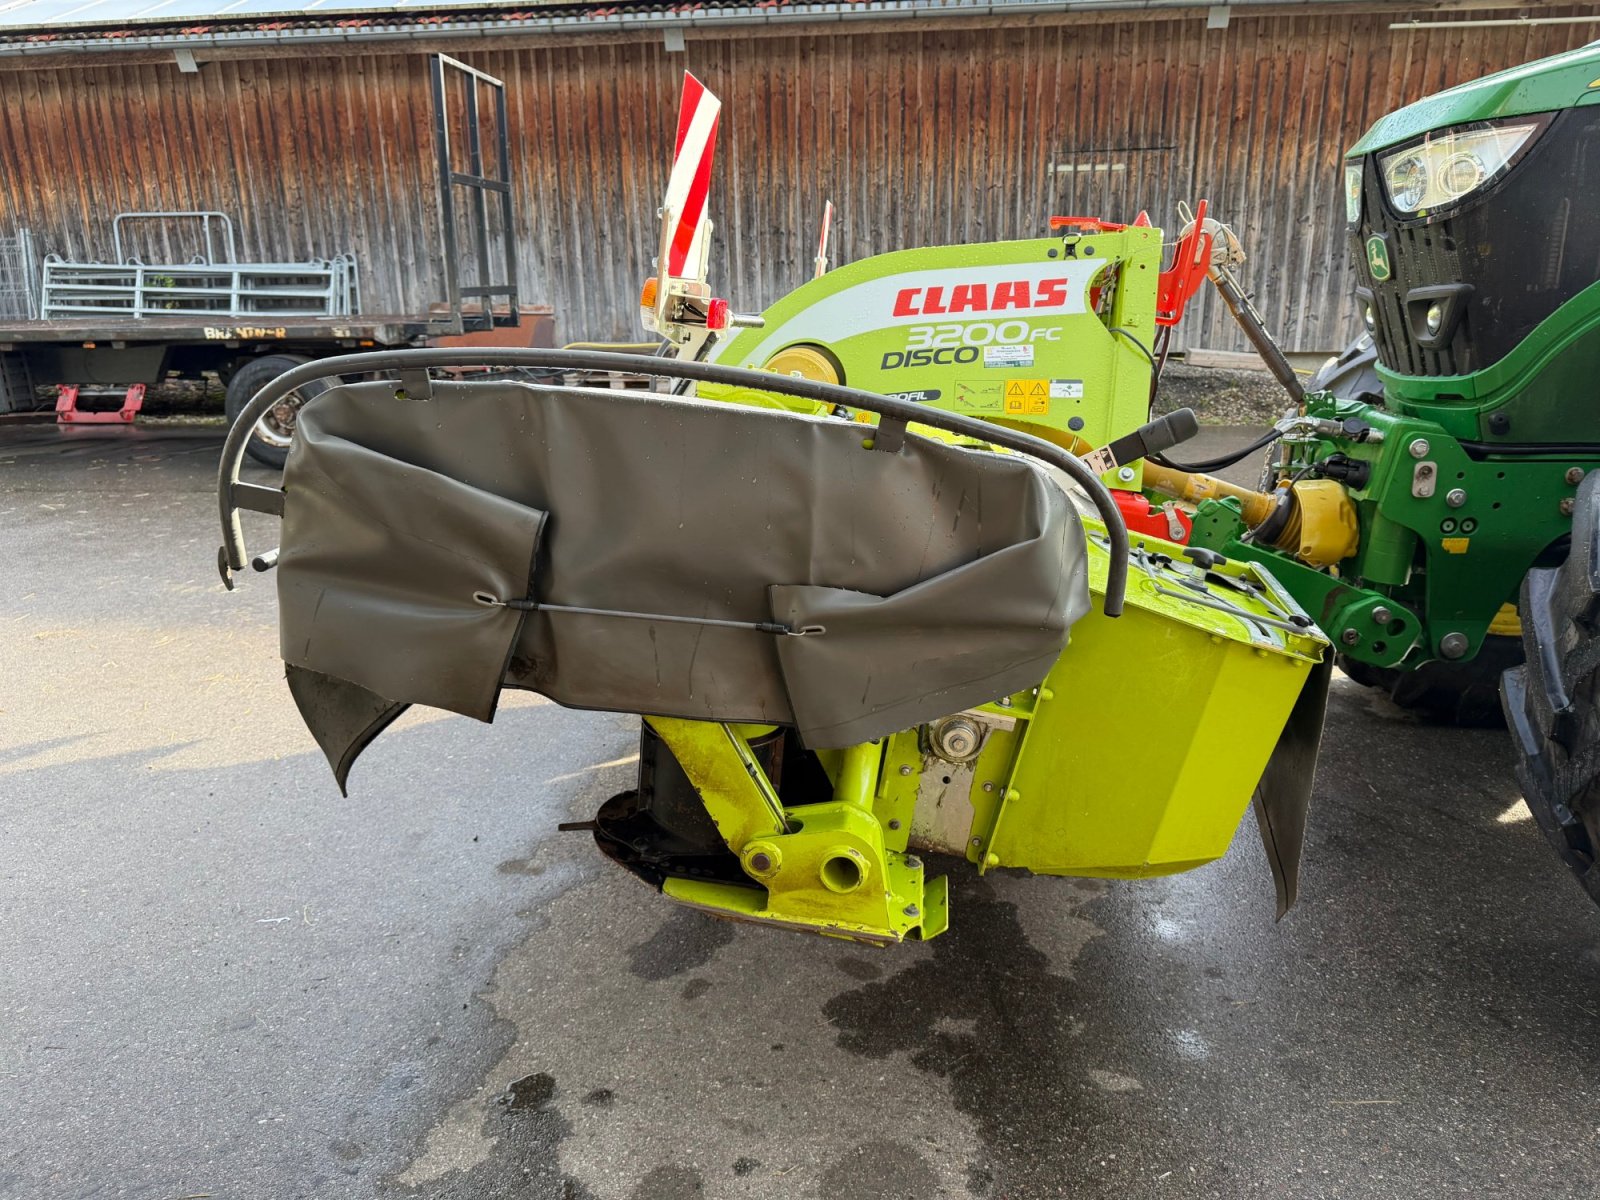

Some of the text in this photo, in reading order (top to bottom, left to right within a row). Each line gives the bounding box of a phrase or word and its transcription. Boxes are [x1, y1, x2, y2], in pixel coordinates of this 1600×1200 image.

[892, 278, 1068, 317] CLAAS
[905, 320, 1030, 350] 3200
[880, 346, 980, 370] DISCO
